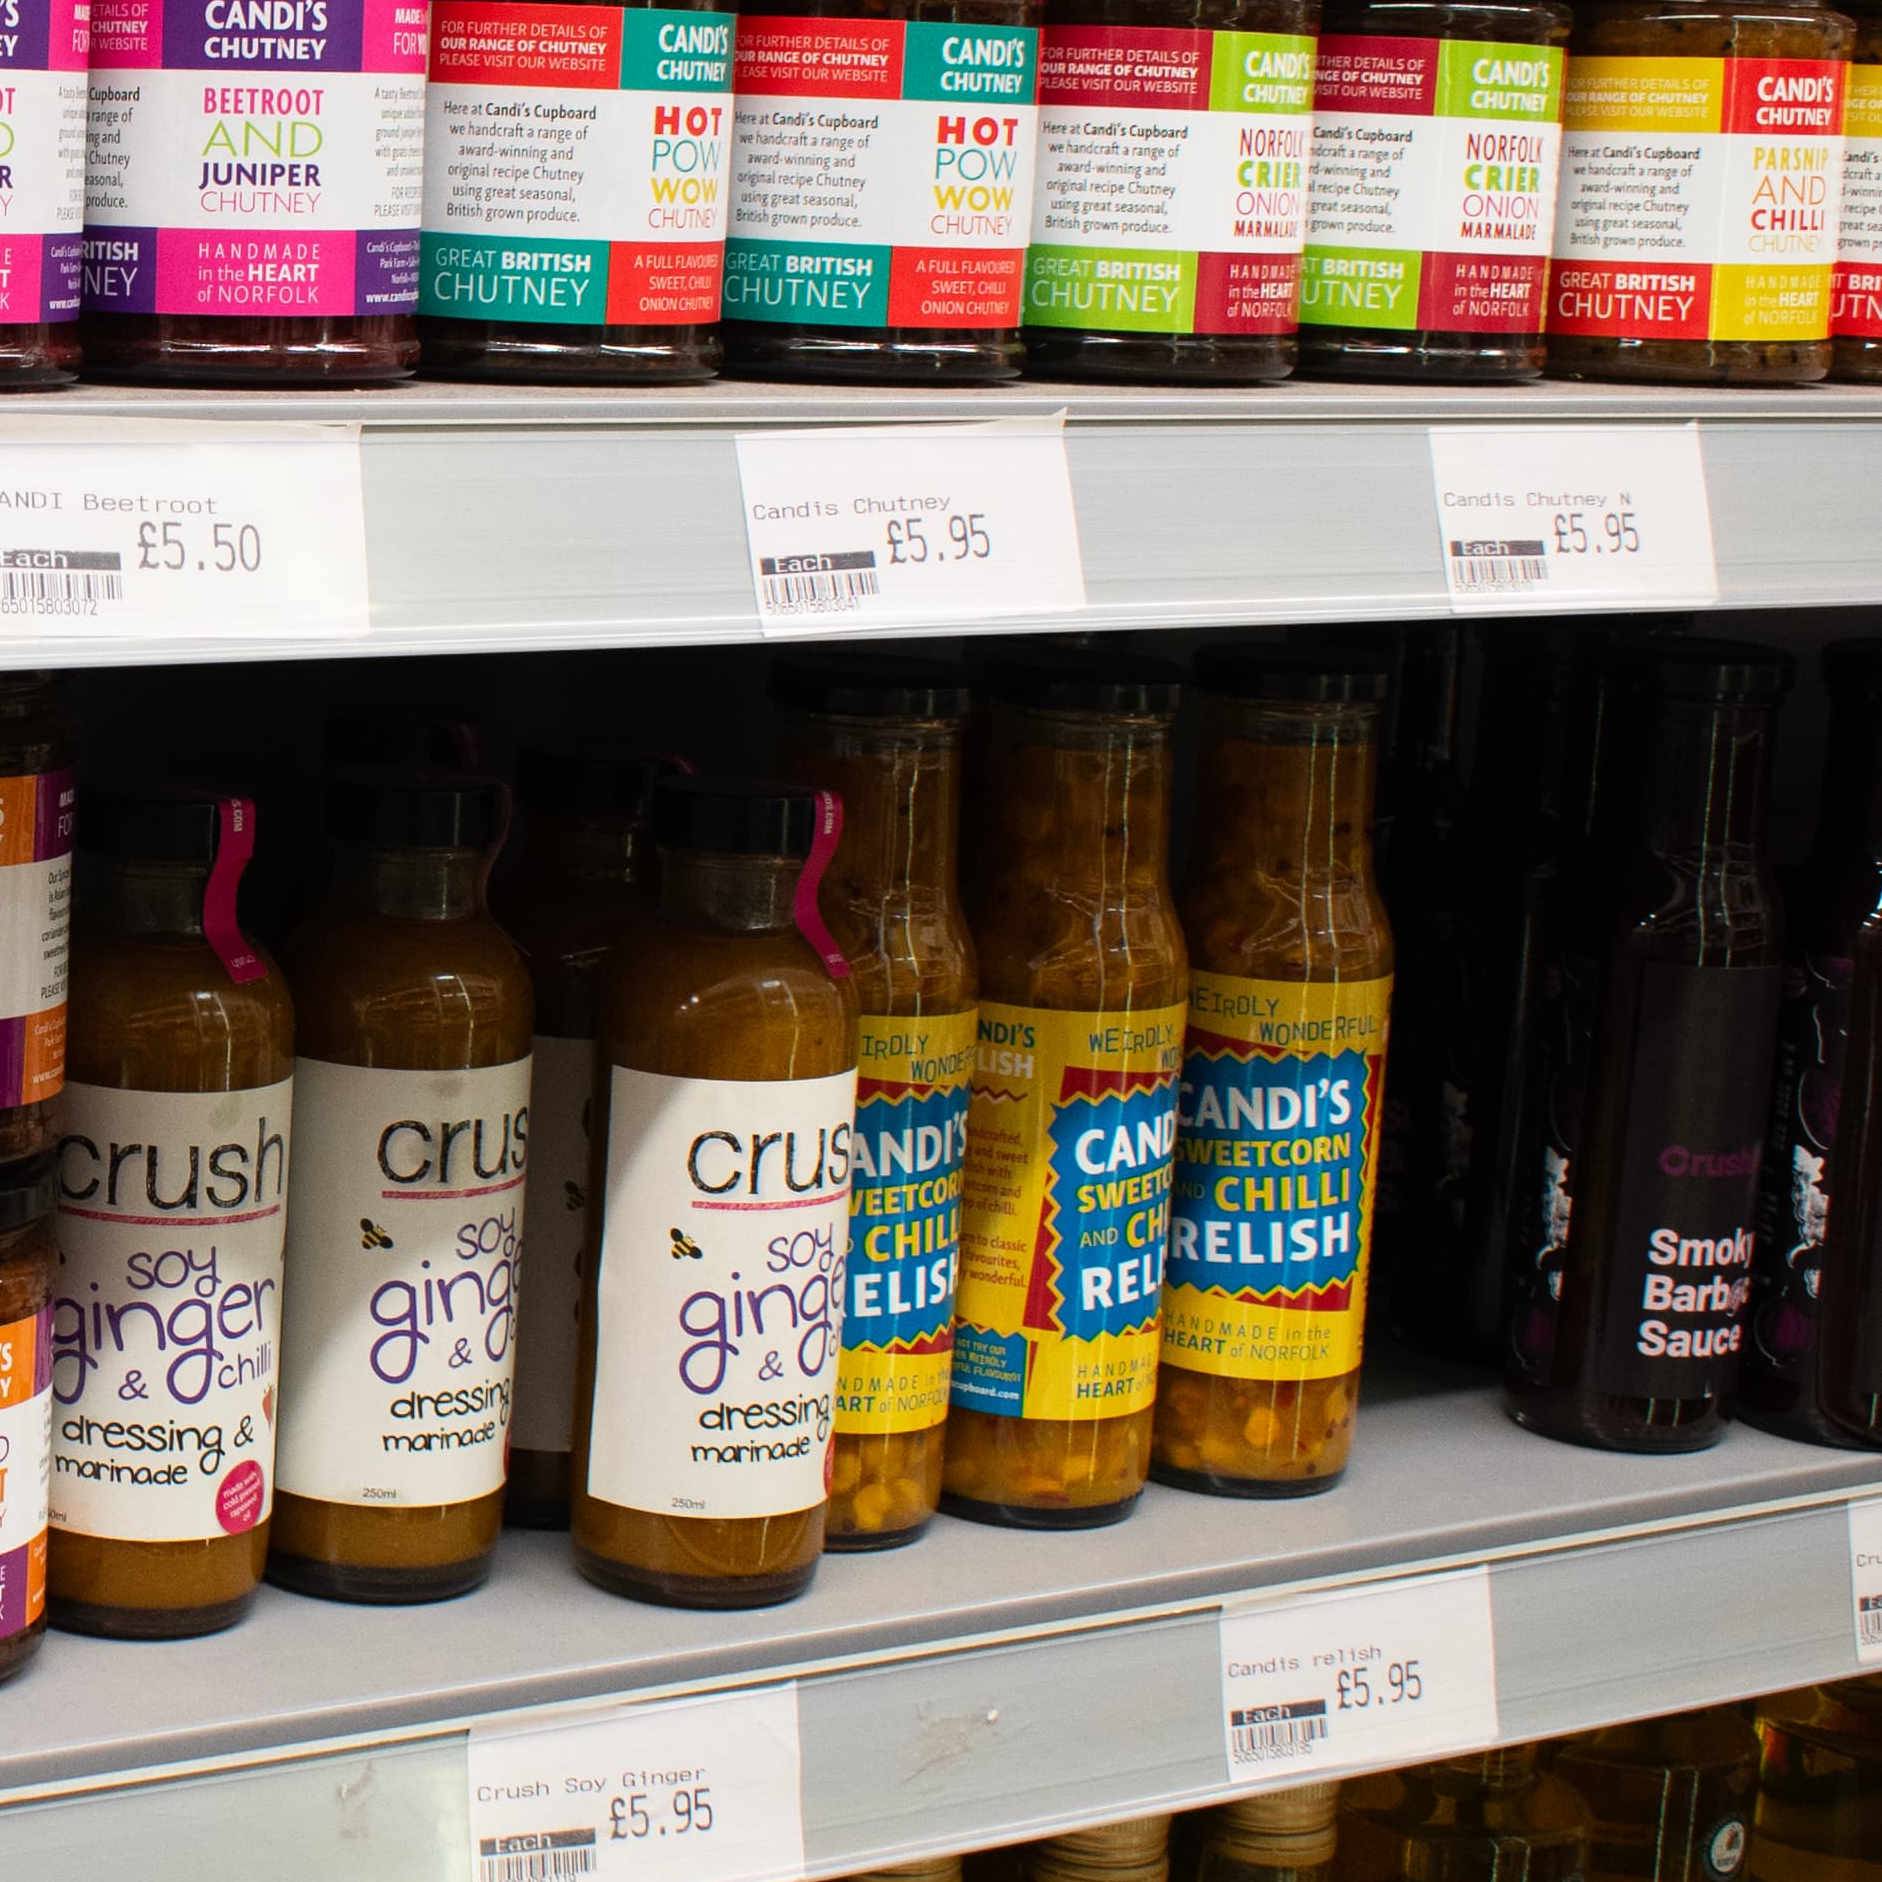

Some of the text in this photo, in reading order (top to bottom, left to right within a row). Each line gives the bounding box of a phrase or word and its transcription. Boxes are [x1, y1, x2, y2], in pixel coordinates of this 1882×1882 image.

[1467, 133, 1542, 163] NORFOLK
[1753, 147, 1829, 172] PARSNIP
[1464, 164, 1540, 193] CRIER
[1463, 194, 1539, 220] ONION
[1751, 210, 1824, 232] CHILLI
[1461, 221, 1536, 241] MARMALADE
[84, 493, 218, 515] Beetroot
[753, 494, 951, 521] Candis Chutney
[1444, 492, 1631, 508] Candis Chutney N
[138, 522, 261, 571] £5.50
[887, 514, 991, 565] £5.95
[1554, 513, 1639, 554] £5.95
[1259, 1014, 1377, 1045] WONDERFUL
[56, 1116, 285, 1212] crush
[1174, 1133, 1351, 1169] SWEETCORN
[1214, 1169, 1351, 1213] CHILLI
[1174, 1212, 1351, 1264] RELISH
[1649, 1227, 1755, 1270] Smoky
[126, 1245, 221, 1298] soy
[51, 1277, 276, 1405] ginger
[1637, 1320, 1741, 1359] Sauce
[218, 1341, 271, 1391] chilli
[62, 1415, 224, 1476] dressing
[55, 1452, 188, 1485] marinade
[1228, 1645, 1382, 1678] Candis relish
[1337, 1660, 1422, 1710] £5.95
[477, 1767, 706, 1802] Crush Soy Ginger
[609, 1788, 713, 1840] £5.95
